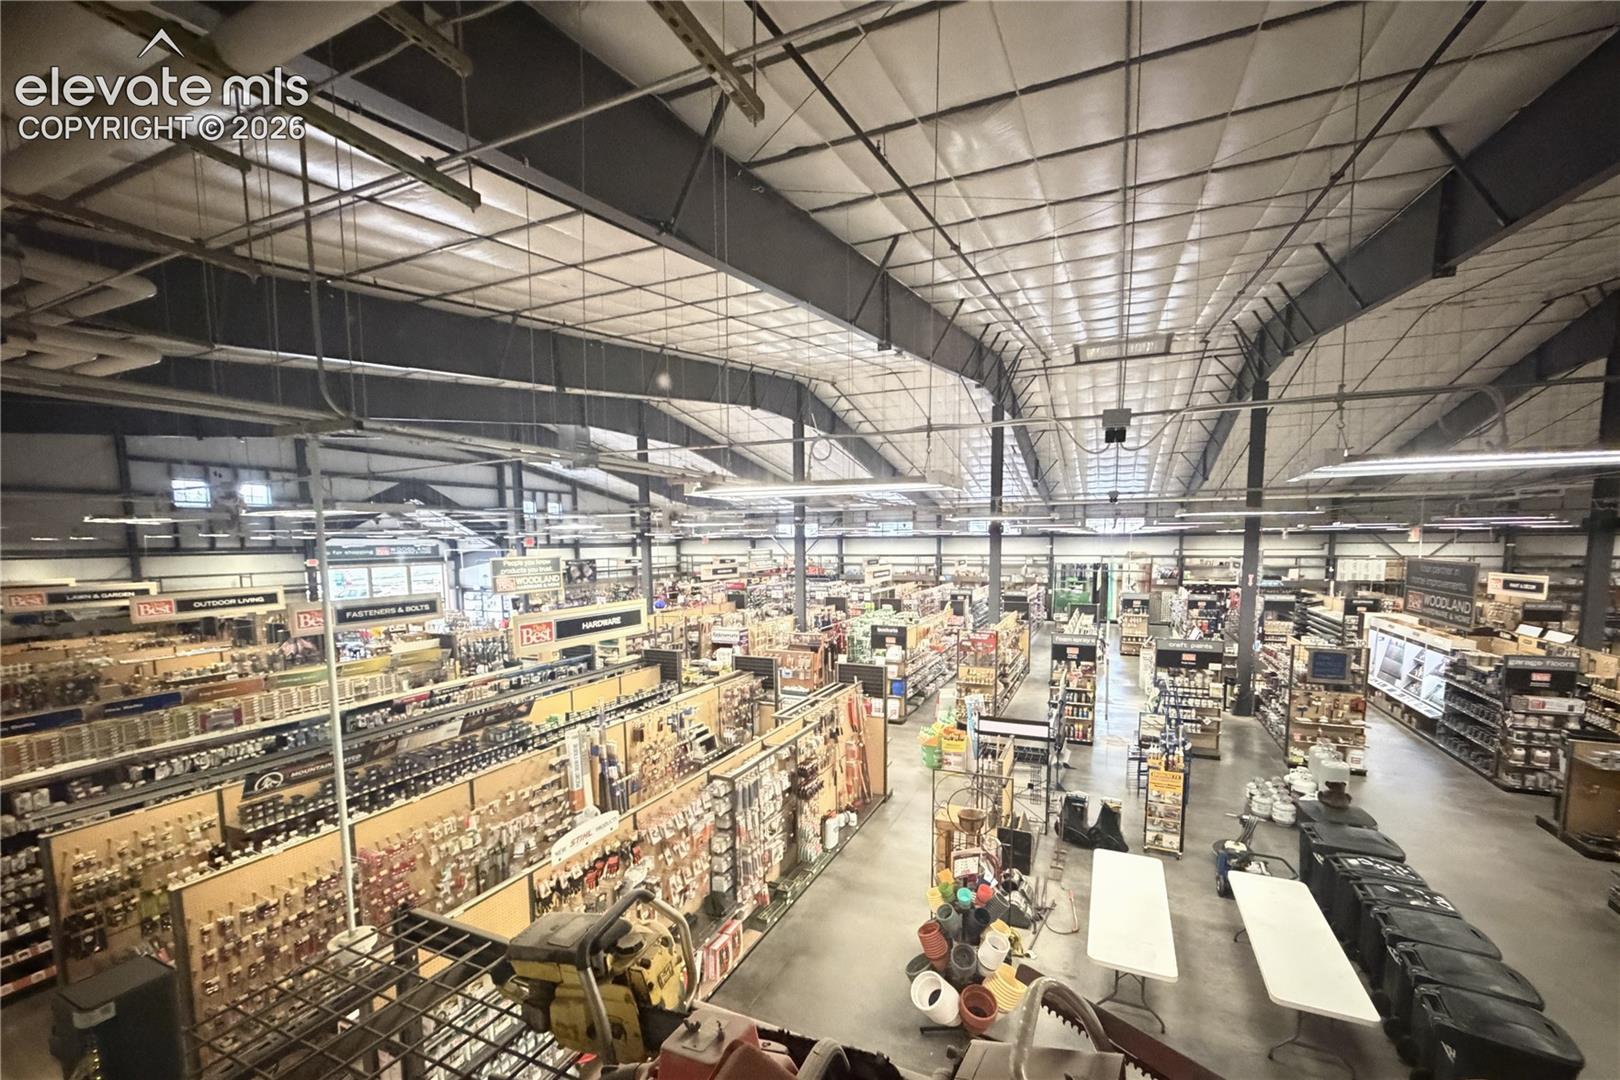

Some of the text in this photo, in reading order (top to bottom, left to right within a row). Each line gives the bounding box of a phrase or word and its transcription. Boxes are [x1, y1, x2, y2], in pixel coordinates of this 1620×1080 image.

[516, 574, 560, 585] WOODLAND
[66, 593, 92, 601] LAWN
[101, 591, 135, 599] GARDEN
[193, 596, 265, 608] OUTDOOR LIVING
[137, 602, 173, 617] Best
[346, 604, 431, 619] FASTENERS & BOLTS
[1424, 595, 1472, 614] WOODLAND
[299, 612, 325, 628] Bes
[581, 616, 622, 630] HARDWARE
[521, 628, 552, 646] Best
[1508, 659, 1577, 669] garage floors
[290, 761, 334, 778] MOUNTAIN
